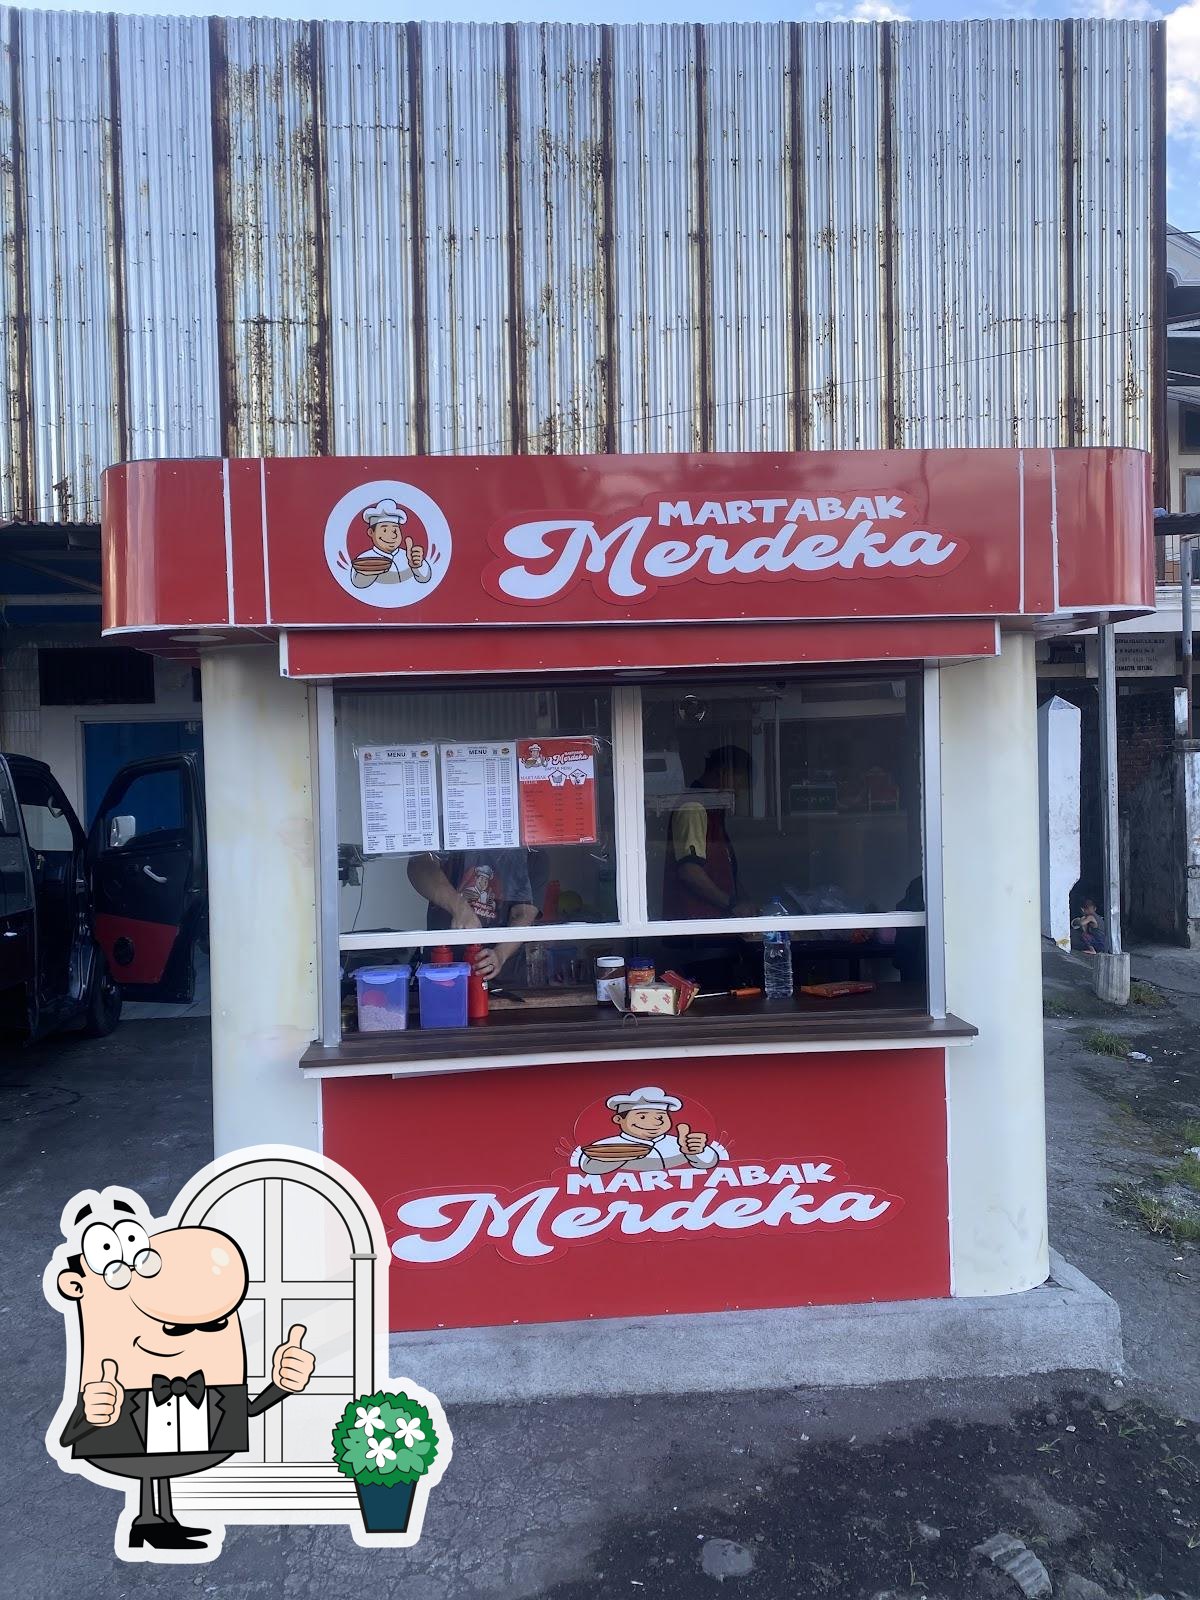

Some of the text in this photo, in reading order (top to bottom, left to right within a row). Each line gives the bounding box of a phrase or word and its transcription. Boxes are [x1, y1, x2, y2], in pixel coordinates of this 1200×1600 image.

[658, 495, 906, 526] MARTABAK
[498, 516, 957, 600] Merdeka
[566, 1162, 836, 1195] MARTABAK
[391, 1184, 892, 1264] Merdeka
